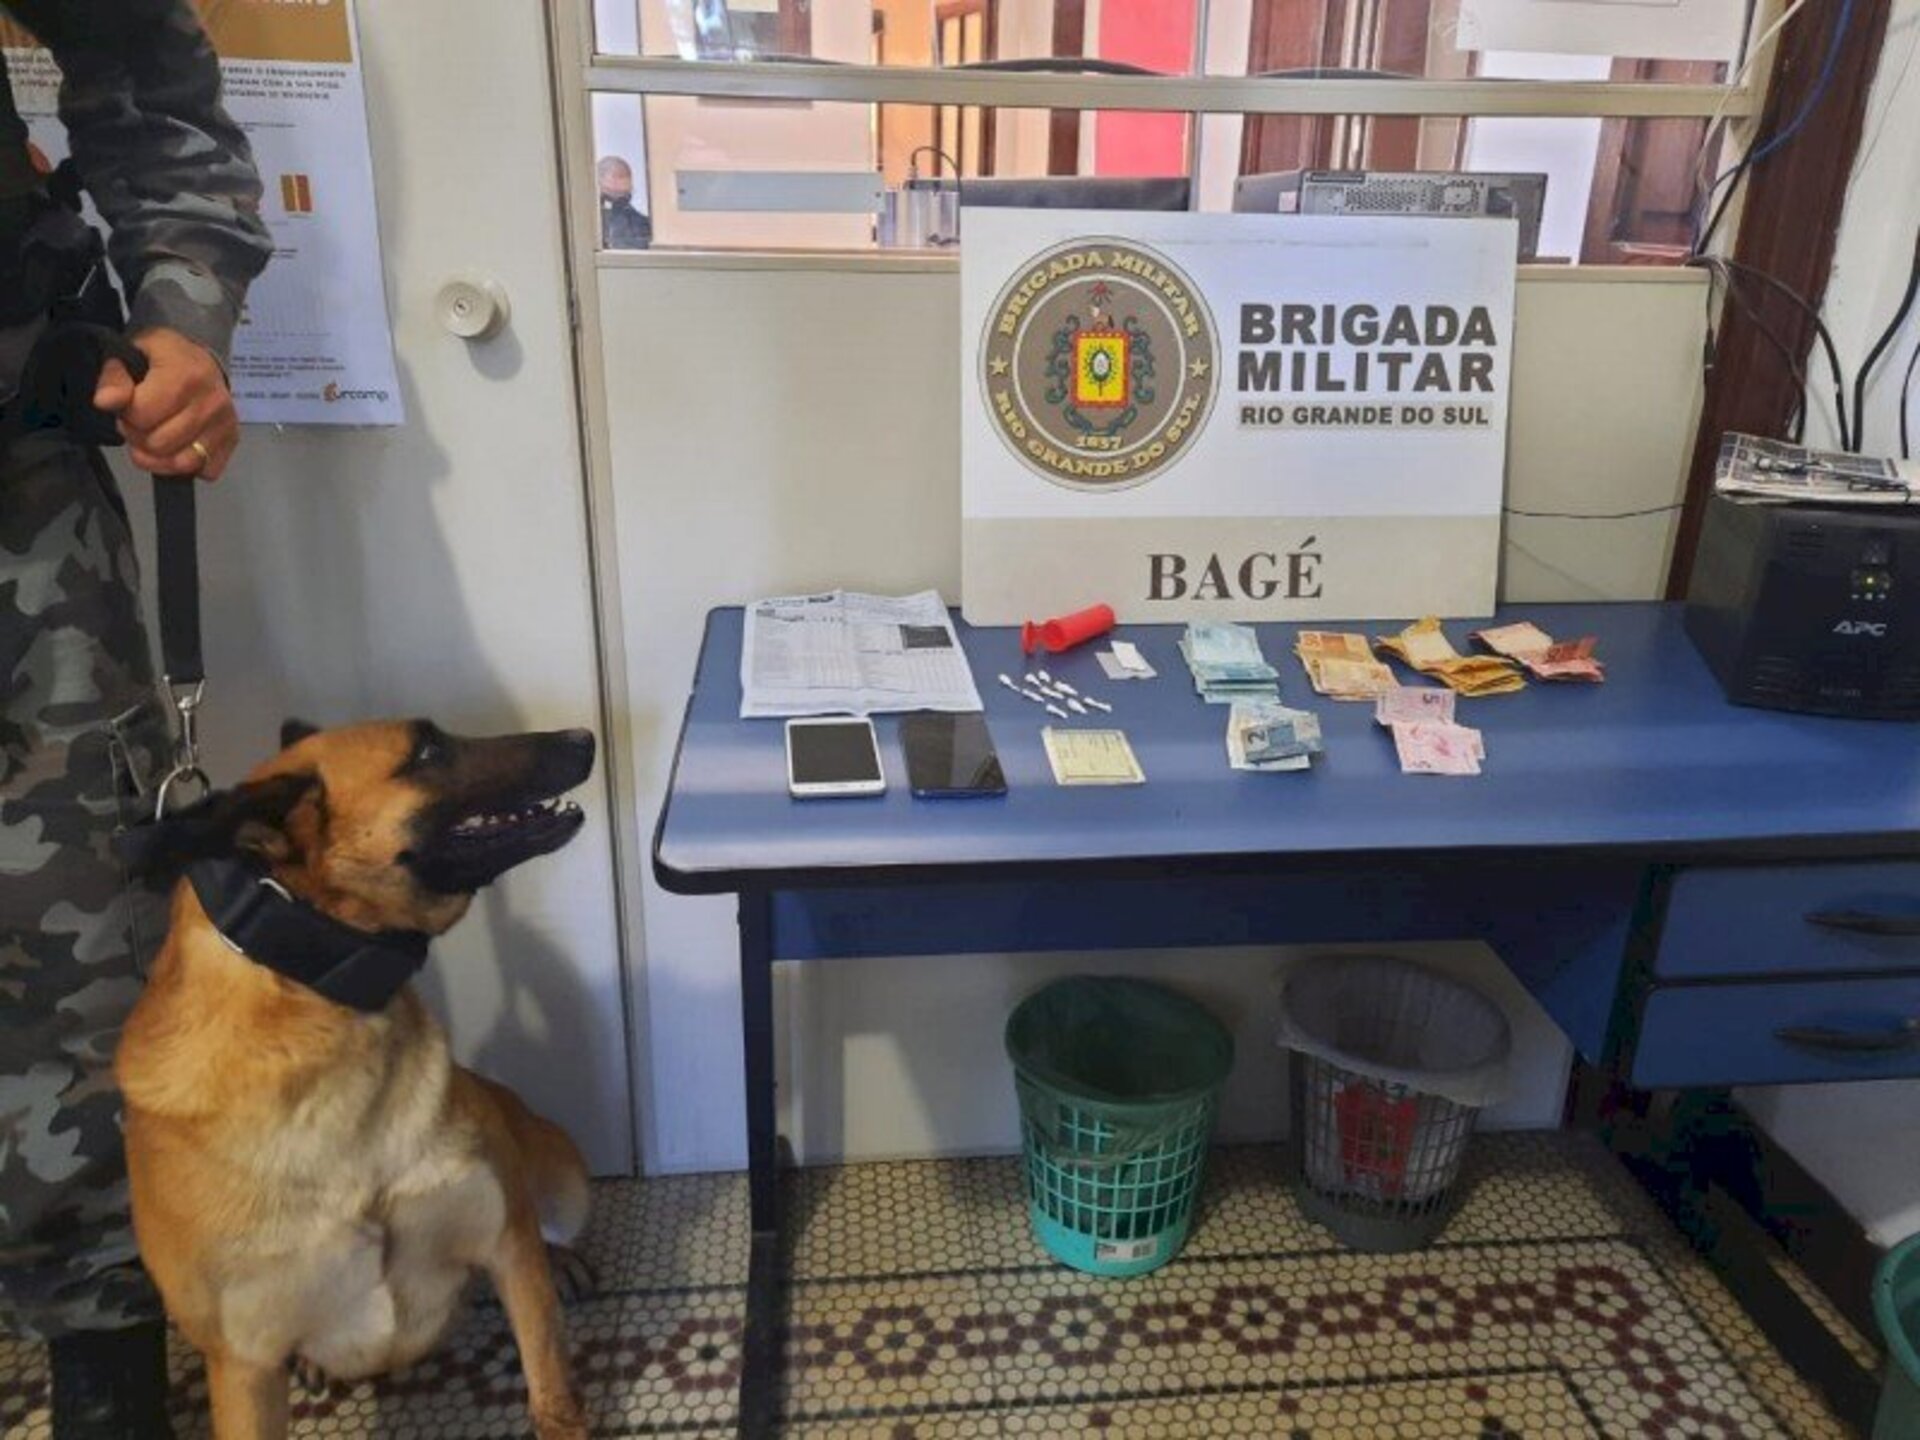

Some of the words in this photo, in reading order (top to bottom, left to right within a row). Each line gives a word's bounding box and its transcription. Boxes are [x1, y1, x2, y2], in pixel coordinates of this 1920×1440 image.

[1000, 251, 1104, 335] BRIGADA
[1110, 252, 1200, 337] MILITAR
[1240, 303, 1497, 346] BRIGADA
[1238, 351, 1495, 392] MILITAR
[996, 391, 1027, 438] RIO
[1027, 440, 1128, 476] GRANDE
[1133, 444, 1165, 469] DO
[1166, 392, 1201, 442] SUL
[1240, 406, 1284, 425] RIO
[1292, 406, 1393, 426] GRANDE
[1401, 407, 1434, 426] DO
[1442, 406, 1488, 426] SUL
[1145, 535, 1323, 600] BAGÉ
[1833, 619, 1887, 637] APC
[1248, 729, 1266, 744] 2
